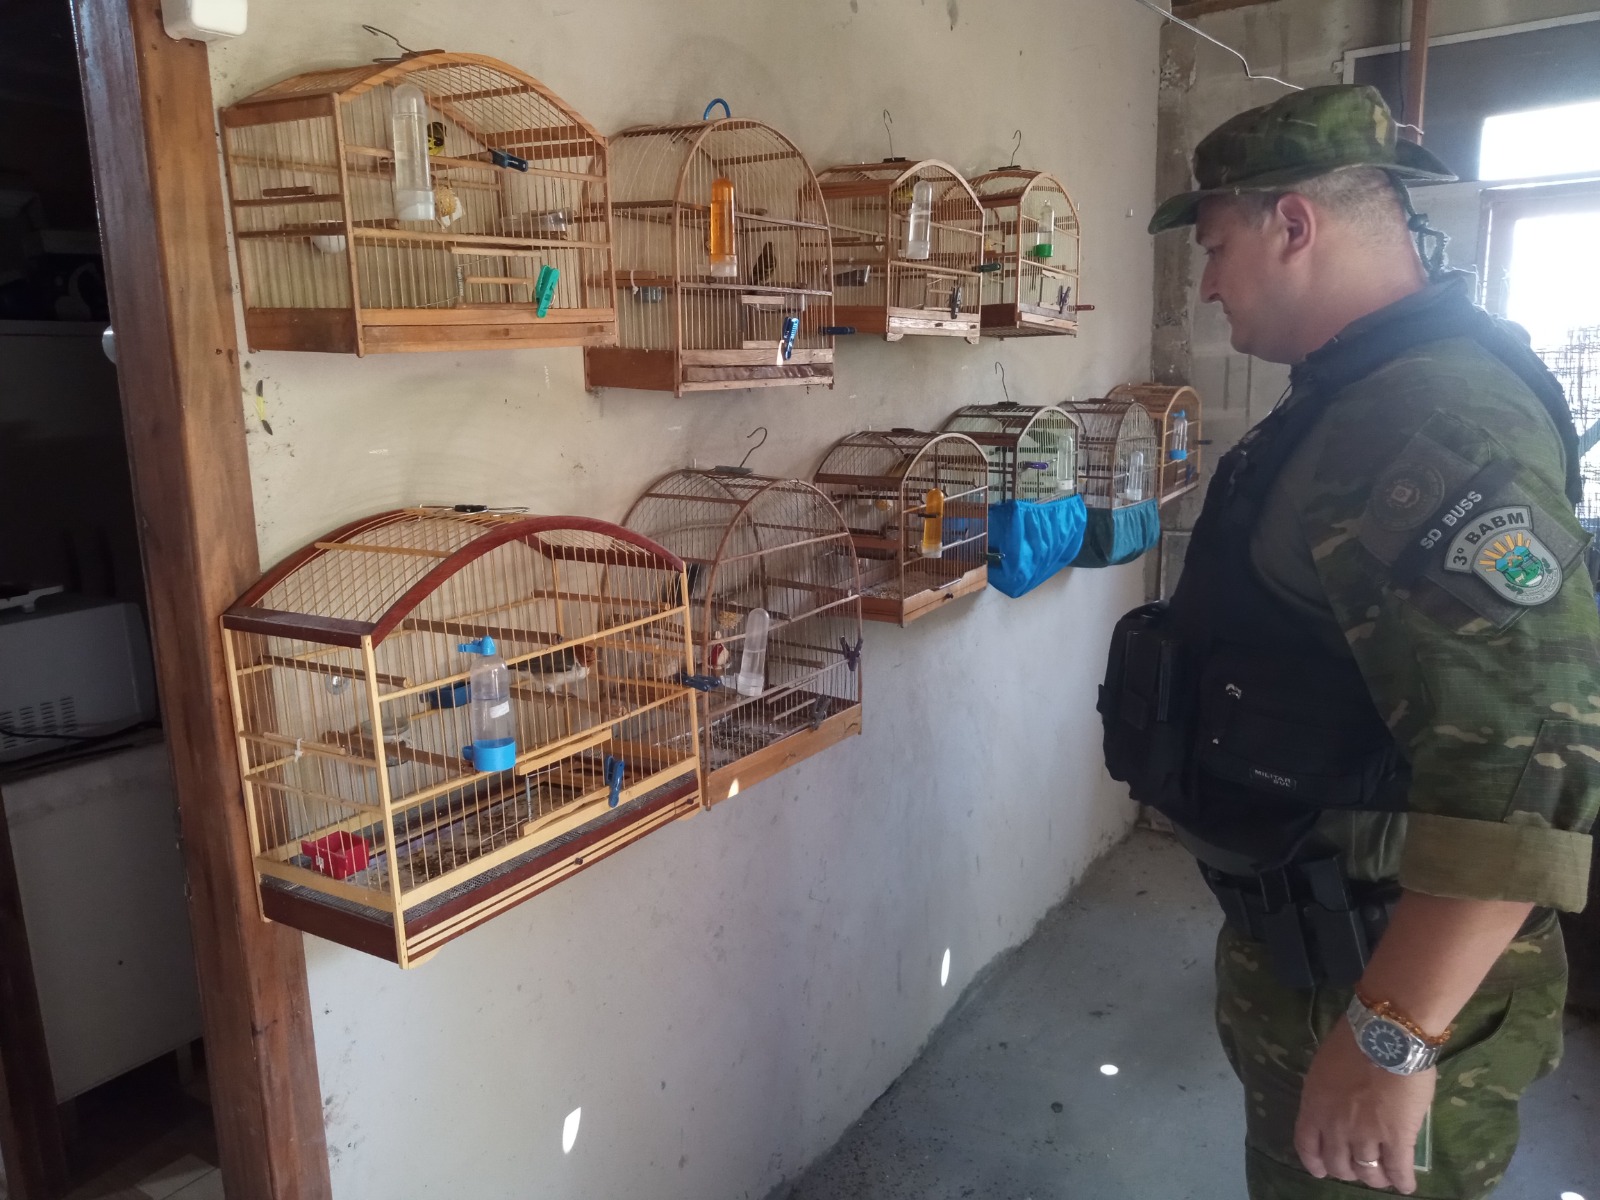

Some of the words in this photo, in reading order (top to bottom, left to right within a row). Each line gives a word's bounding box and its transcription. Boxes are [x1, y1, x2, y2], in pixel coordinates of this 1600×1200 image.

[1420, 528, 1442, 549] SD
[1442, 490, 1482, 526] BUSS
[1465, 512, 1525, 545] BABM
[1254, 768, 1291, 783] MILITAR
